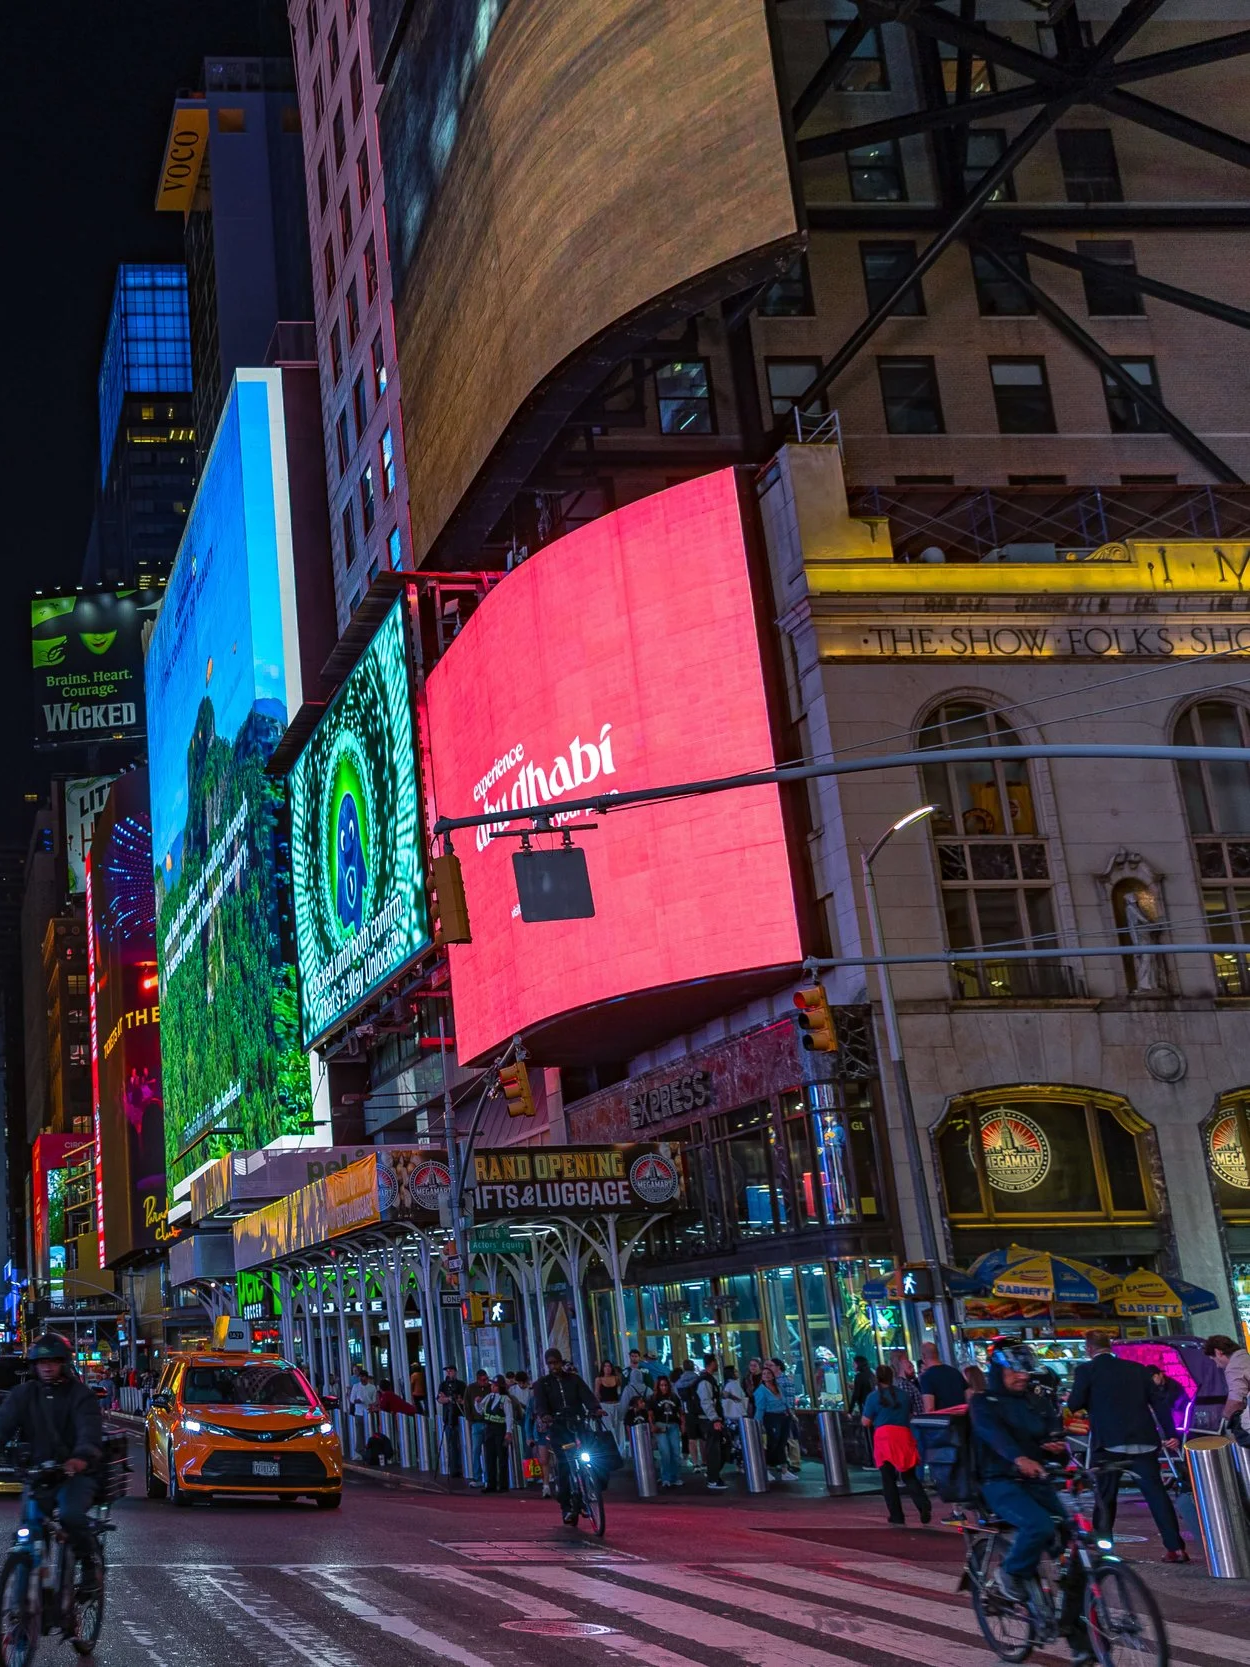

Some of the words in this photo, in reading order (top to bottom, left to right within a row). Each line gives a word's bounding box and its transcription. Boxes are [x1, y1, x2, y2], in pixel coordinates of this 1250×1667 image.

[163, 131, 199, 192] VOCO
[869, 628, 938, 656] THE
[950, 628, 1047, 656] SHOW
[1069, 627, 1174, 655] FOLKS
[46, 673, 91, 687] Brains.
[93, 669, 133, 682] Heart.
[62, 683, 118, 698] Courage.
[473, 743, 524, 802] experience
[205, 839, 226, 883] walking
[226, 791, 248, 849] through
[310, 953, 334, 999] Locked
[335, 943, 350, 980] until
[351, 925, 370, 961] both
[370, 895, 405, 943] confirm.
[320, 987, 341, 1025] That's
[341, 967, 364, 1005] 2-Way
[125, 1007, 160, 1029] THE
[630, 1071, 706, 1129] EXPRESS
[307, 1149, 365, 1184] pel
[474, 1153, 531, 1181] RAND
[535, 1151, 626, 1179] OPENING
[475, 1184, 518, 1210] IFTS
[472, 1240, 498, 1248] Actors'
[501, 1241, 524, 1250] Equity
[478, 1230, 485, 1239] W
[490, 1229, 500, 1238] 46
[997, 1284, 1050, 1297] SABRETT
[1118, 1304, 1178, 1313] SABRETT
